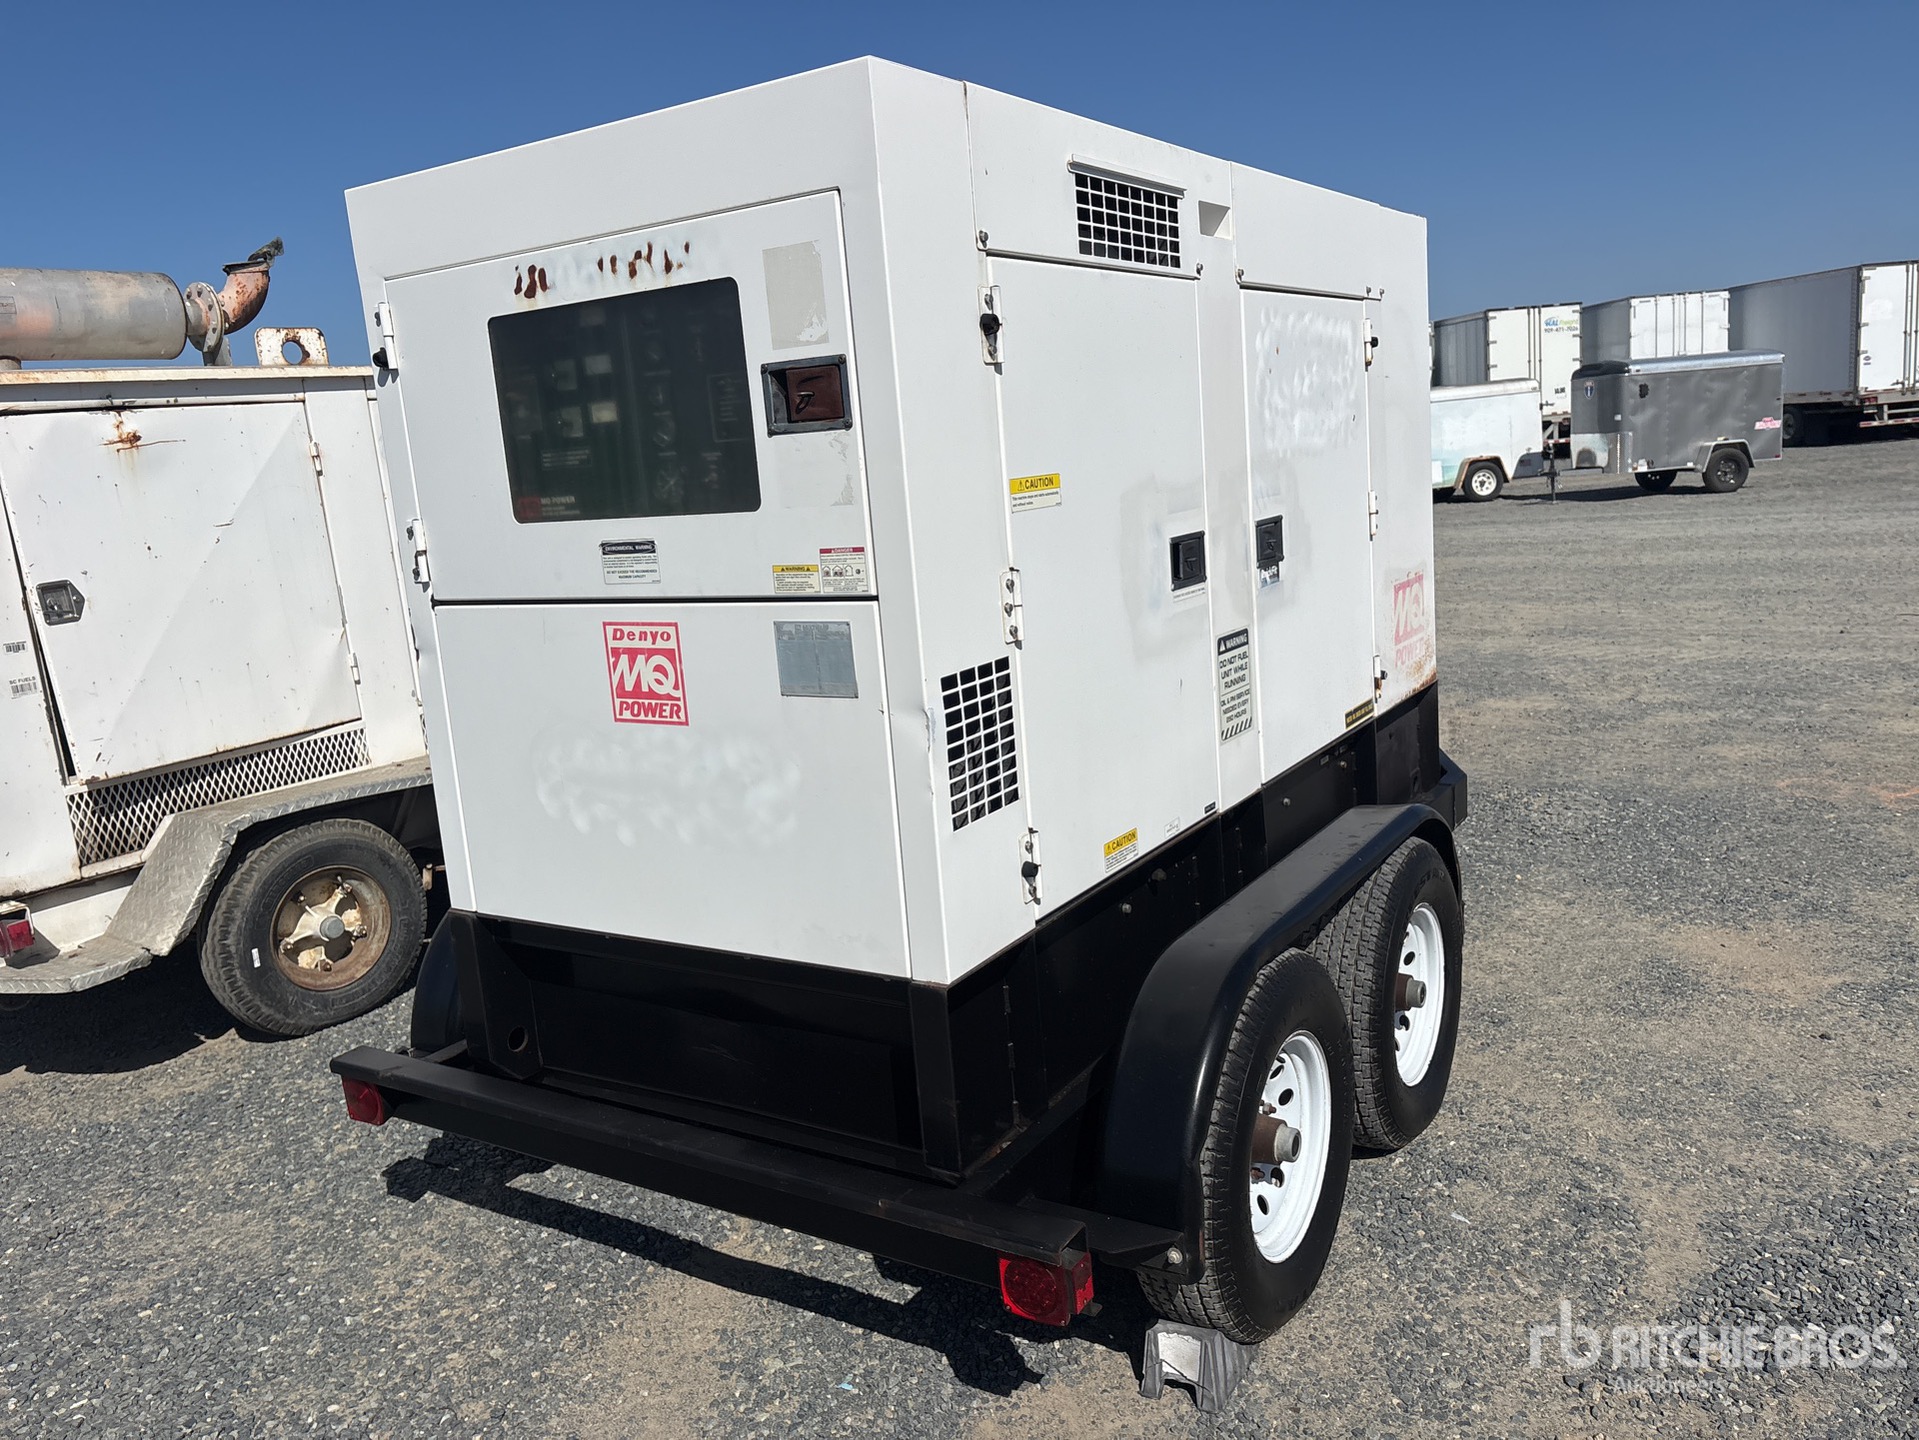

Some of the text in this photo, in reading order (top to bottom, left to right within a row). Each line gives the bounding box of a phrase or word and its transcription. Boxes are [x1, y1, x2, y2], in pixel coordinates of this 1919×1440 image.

[1025, 476, 1054, 490] CAUTION
[612, 627, 672, 645] Denyo
[1226, 633, 1248, 649] WARNING
[1219, 650, 1249, 669] DO NOT FUEL
[18, 675, 36, 684] FUELS
[612, 654, 681, 698] MQ
[1221, 661, 1248, 680] UNIT WHILE
[1224, 673, 1246, 690] RUNNING
[619, 700, 682, 720] POWER
[1111, 830, 1137, 850] CAUTION
